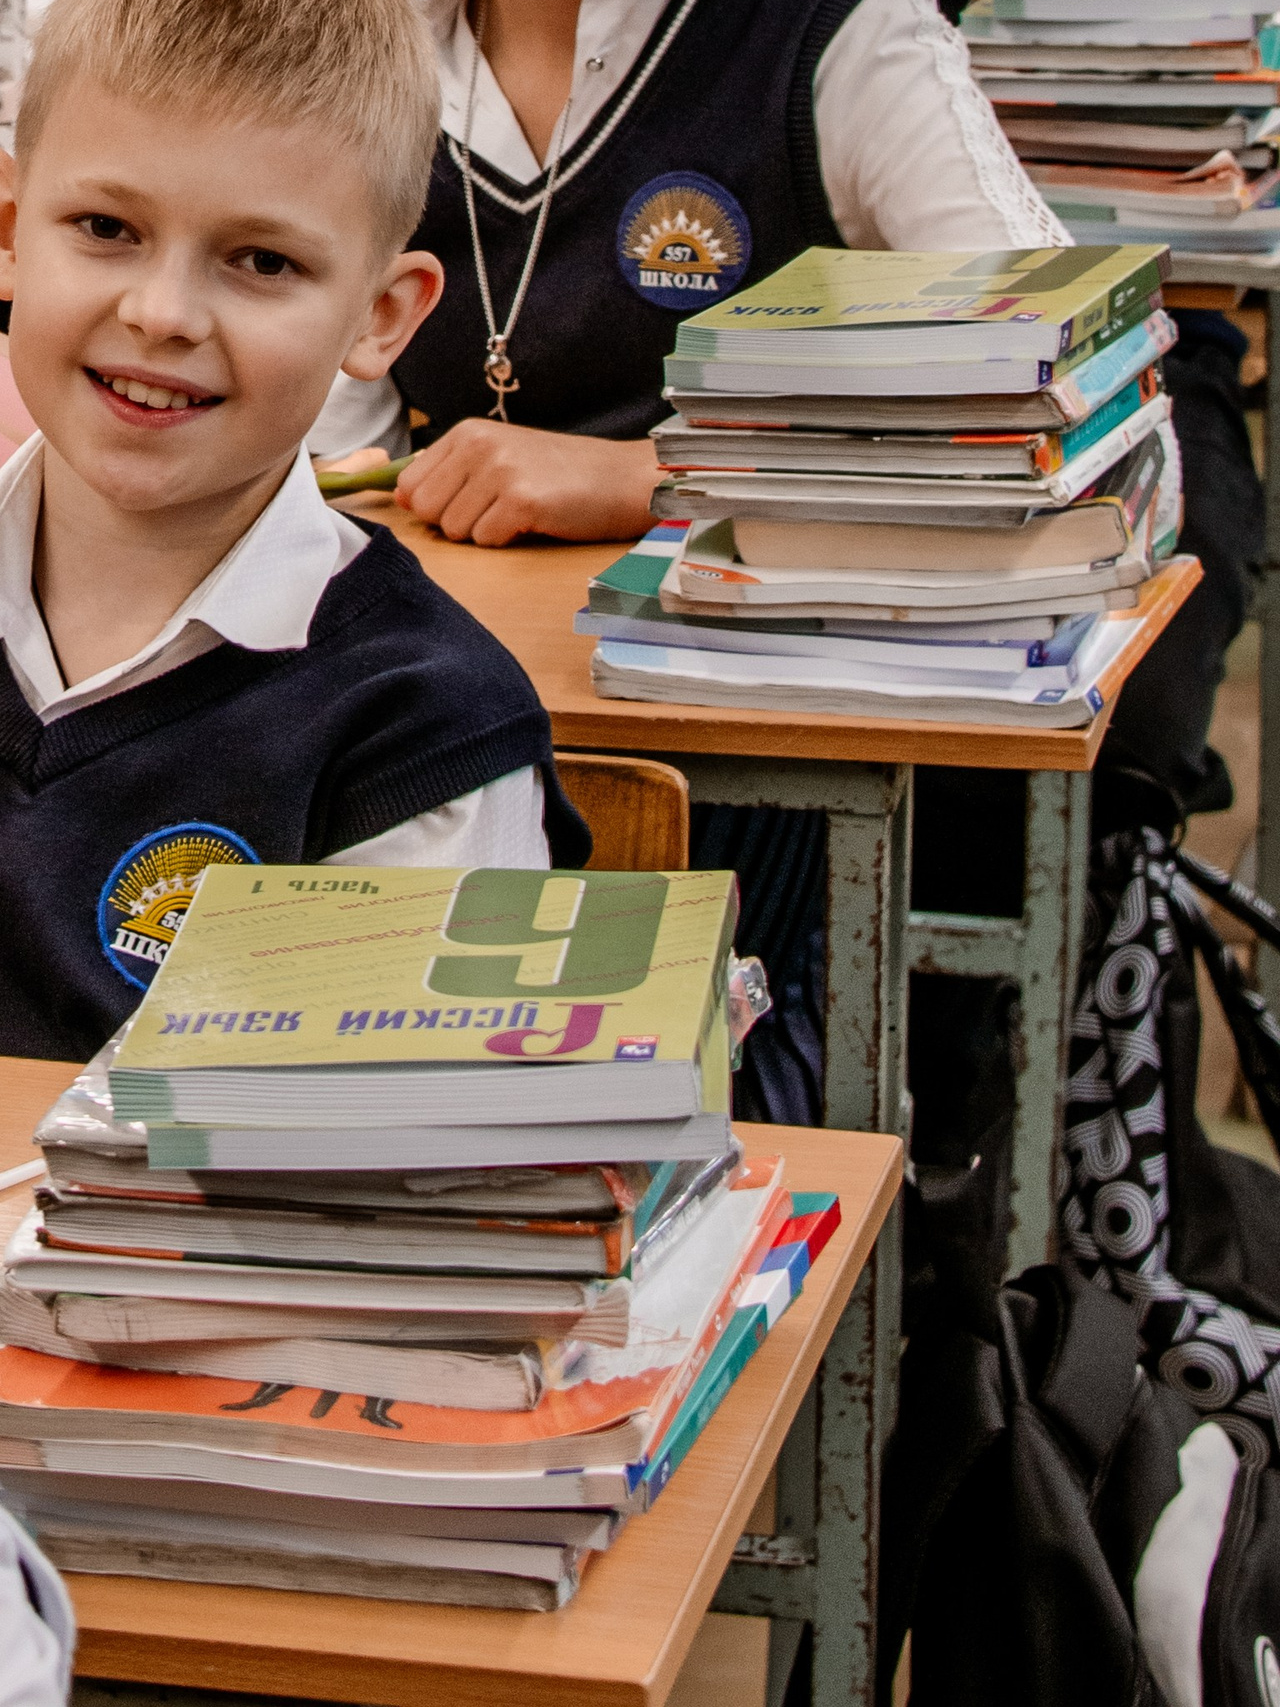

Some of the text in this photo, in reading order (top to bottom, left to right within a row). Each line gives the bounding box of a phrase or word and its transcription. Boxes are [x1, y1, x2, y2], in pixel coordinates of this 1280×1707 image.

[664, 245, 692, 263] 557
[639, 269, 719, 291] ШКОЛА
[724, 295, 1037, 318] Русский язык
[250, 879, 379, 895] Часть 1
[161, 910, 188, 932] 55
[424, 867, 671, 998] 6
[157, 1010, 303, 1035] язык
[333, 1000, 623, 1056] Русский
